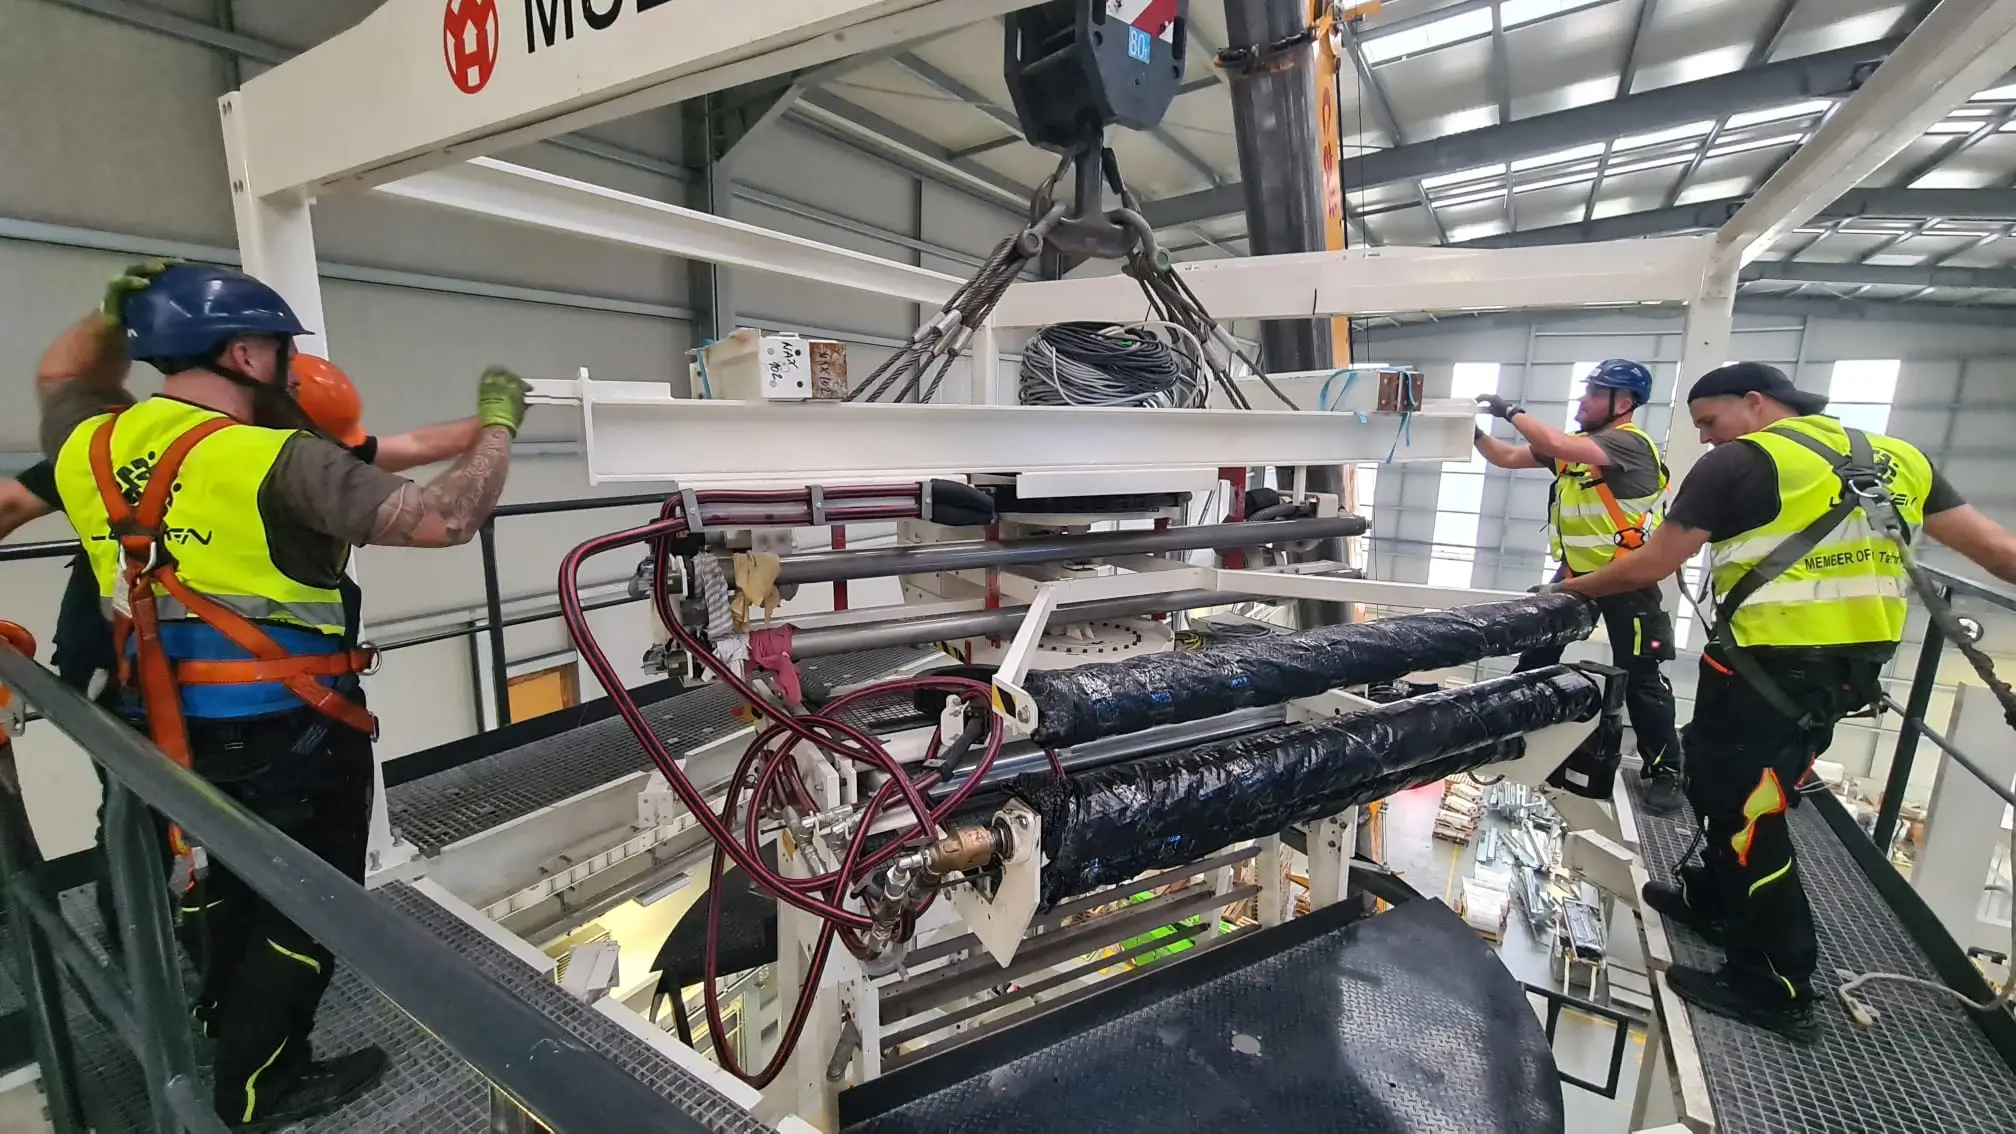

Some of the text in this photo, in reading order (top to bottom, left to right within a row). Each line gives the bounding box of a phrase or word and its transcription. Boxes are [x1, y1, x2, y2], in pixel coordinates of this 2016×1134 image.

[781, 341, 799, 369] NAX
[768, 361, 783, 380] 102
[1804, 552, 1854, 570] MEMBER
[1856, 549, 1871, 562] OF
